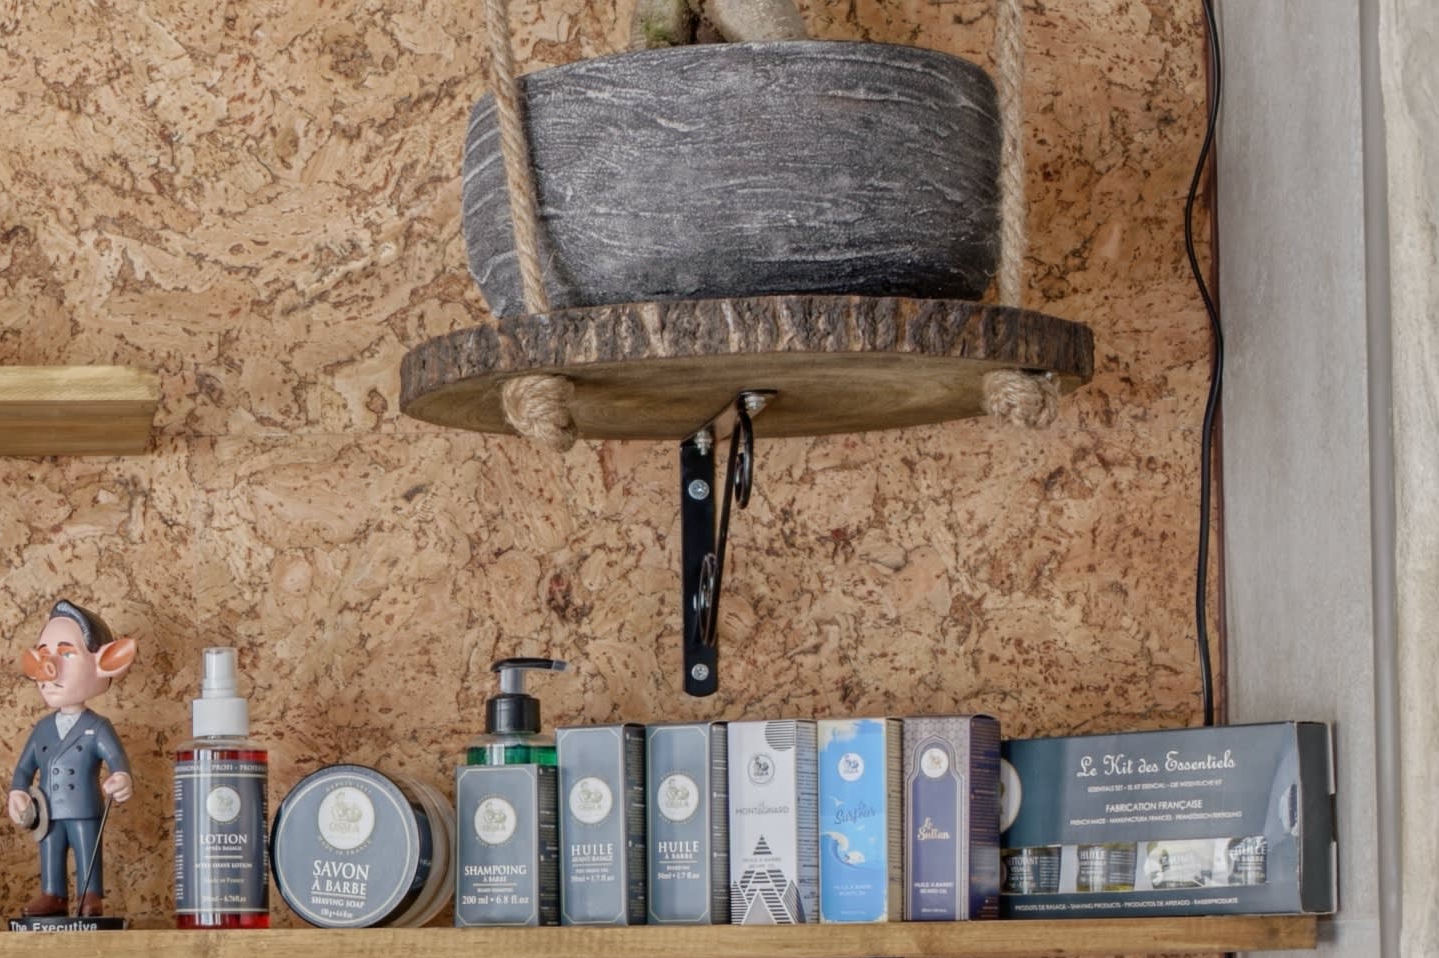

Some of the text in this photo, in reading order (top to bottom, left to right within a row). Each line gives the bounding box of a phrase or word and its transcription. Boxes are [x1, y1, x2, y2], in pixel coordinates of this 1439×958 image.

[1077, 750, 1235, 777] Le Kit des Essentiels
[1106, 799, 1203, 813] FABRICATION FRANÇAISE
[200, 833, 248, 845] LOTION
[571, 843, 613, 856] HUILE
[658, 840, 699, 853] HUILE
[313, 860, 369, 880] SAVON
[464, 864, 527, 876] SHAMPOING
[312, 876, 367, 895] À BARBE
[462, 896, 476, 904] 200
[478, 896, 488, 904] ml
[10, 921, 98, 932] The Executive
